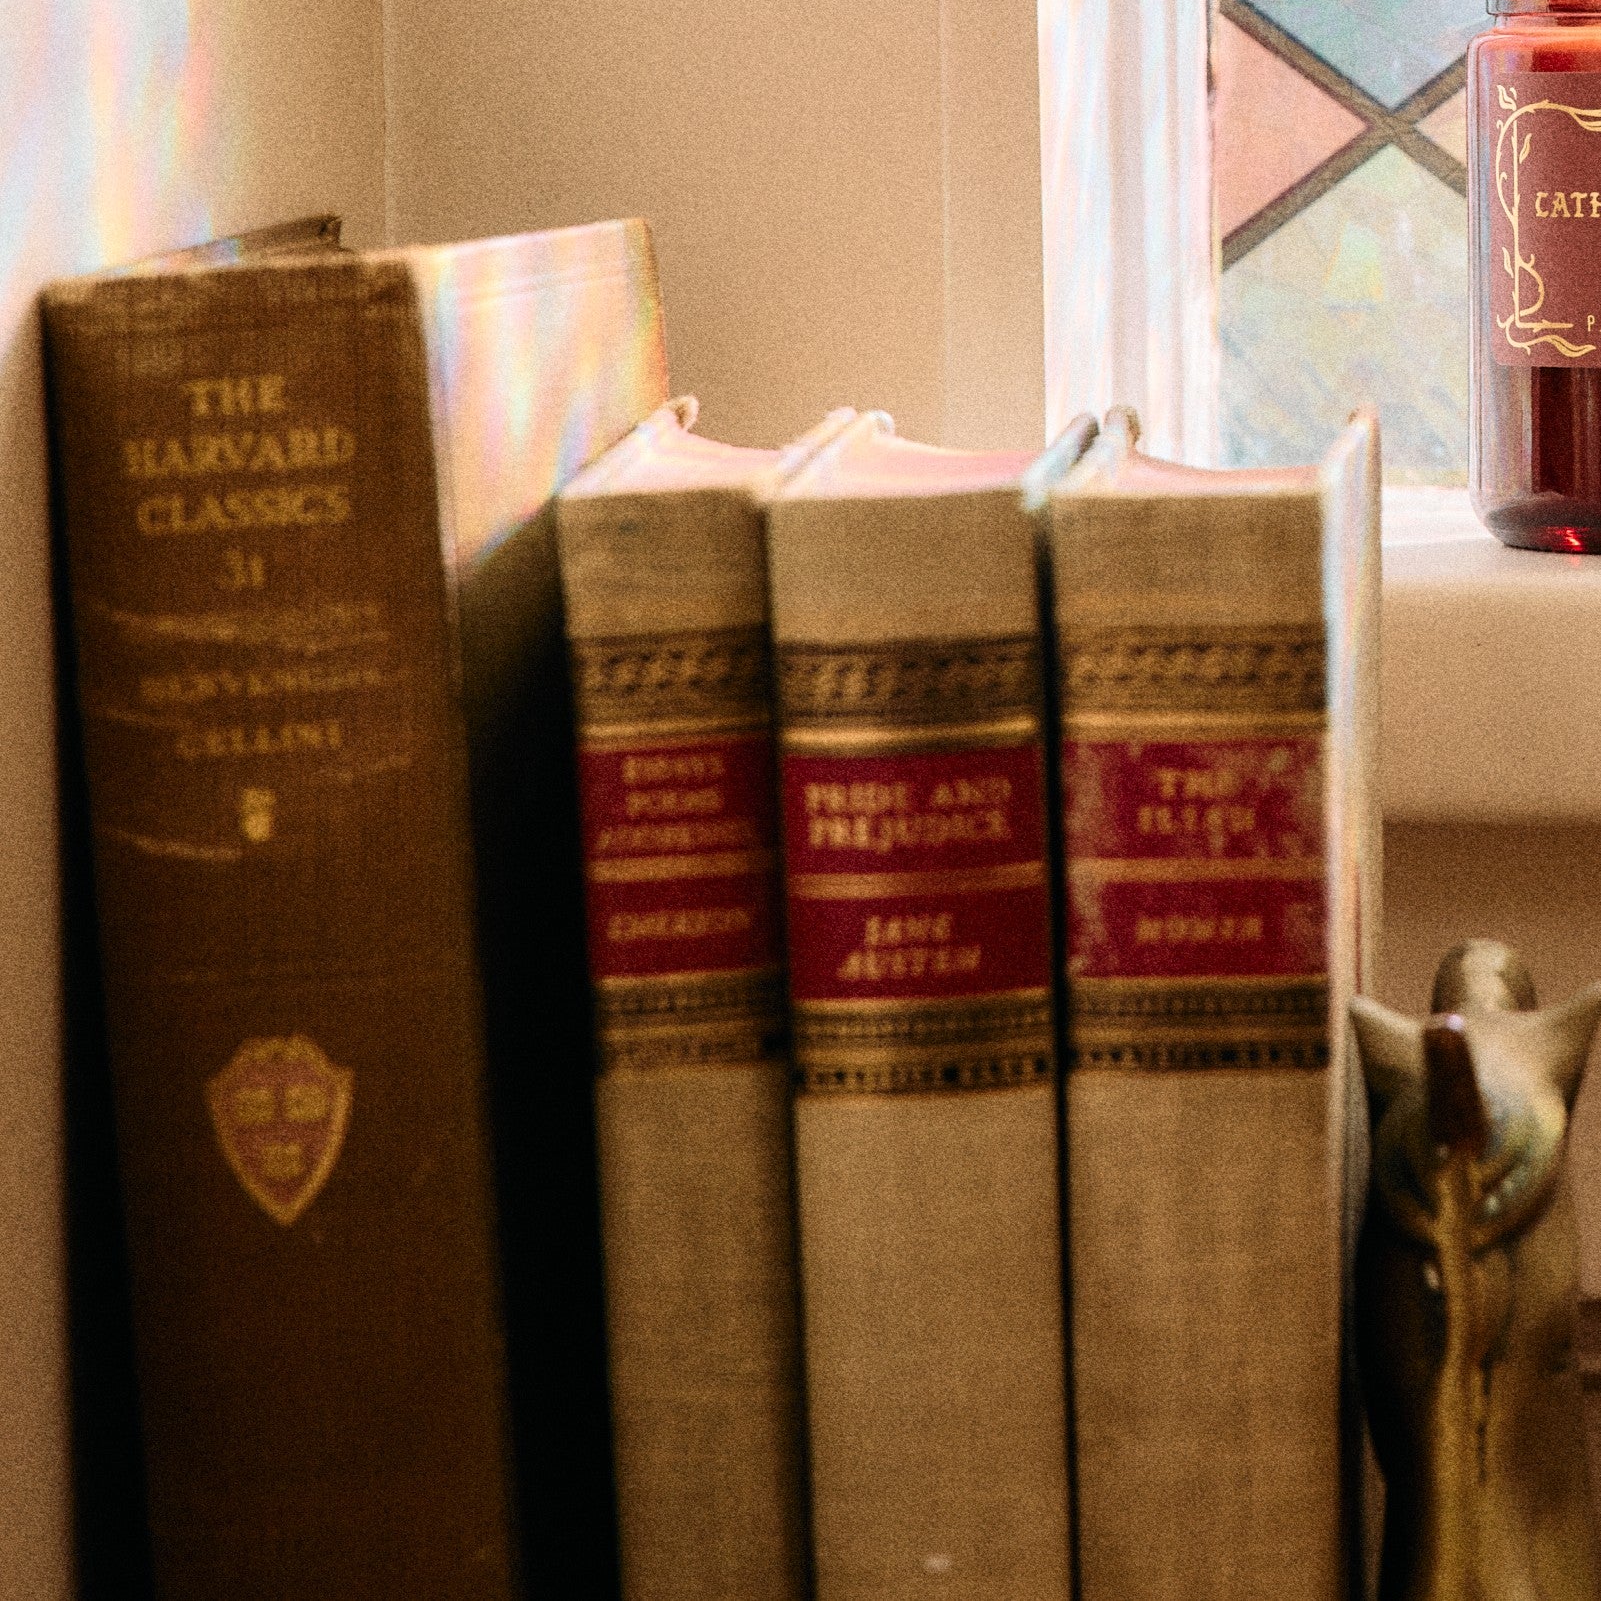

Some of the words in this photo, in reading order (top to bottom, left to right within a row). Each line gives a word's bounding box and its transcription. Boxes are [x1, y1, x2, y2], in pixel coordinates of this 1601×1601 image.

[181, 374, 286, 417] THE
[121, 427, 357, 479] HARVARD
[136, 485, 352, 537] CLASSICS
